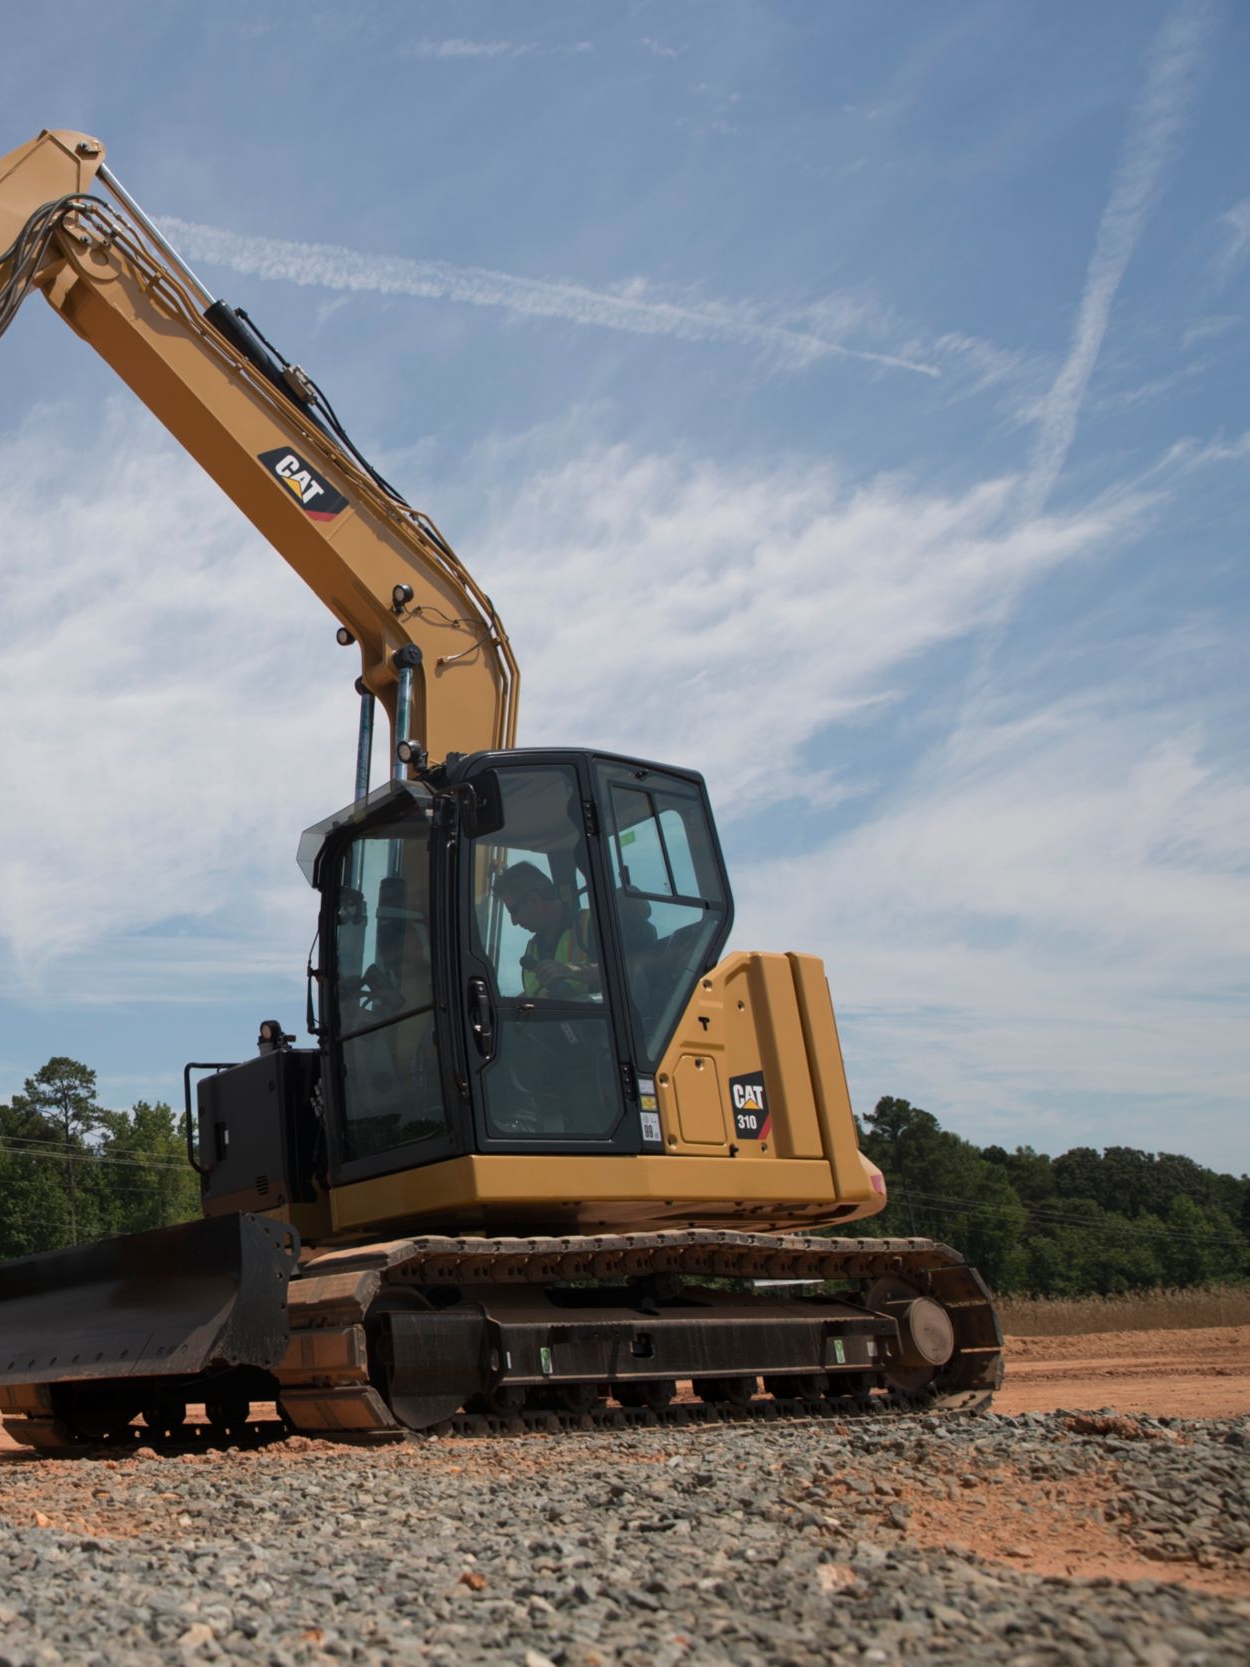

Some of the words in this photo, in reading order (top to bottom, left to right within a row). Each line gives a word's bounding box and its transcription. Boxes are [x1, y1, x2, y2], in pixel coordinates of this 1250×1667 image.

[275, 454, 325, 504] CAT
[732, 1084, 764, 1110] CAT
[737, 1114, 757, 1129] 310
